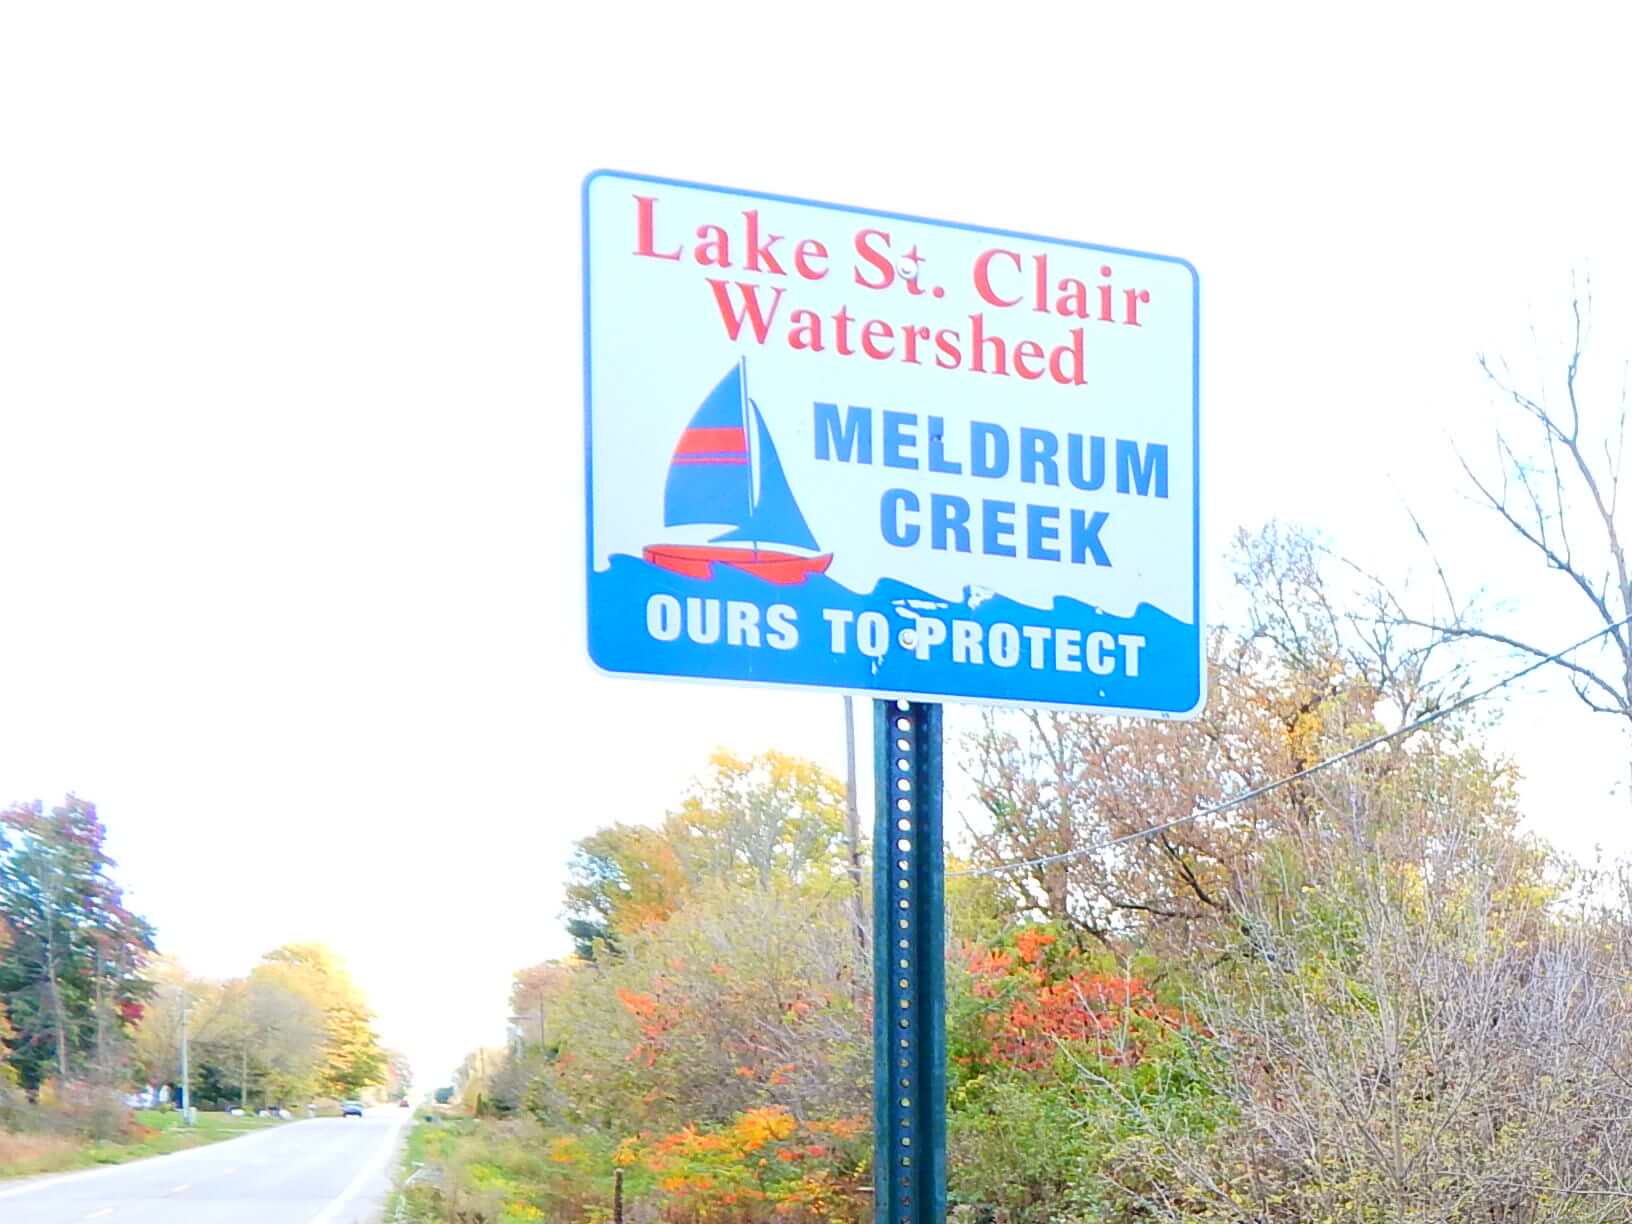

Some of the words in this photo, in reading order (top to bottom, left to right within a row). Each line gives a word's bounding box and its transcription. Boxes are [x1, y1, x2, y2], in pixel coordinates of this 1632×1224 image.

[631, 194, 830, 281] Lake
[854, 229, 945, 299] St.
[973, 247, 1150, 328] Clair
[705, 277, 1088, 386] Watershed
[813, 401, 1169, 499] MELDRUM
[879, 488, 1113, 568] CREEK
[645, 594, 799, 650] OURS
[823, 609, 888, 657] TO
[914, 617, 1146, 677] PROTECT
